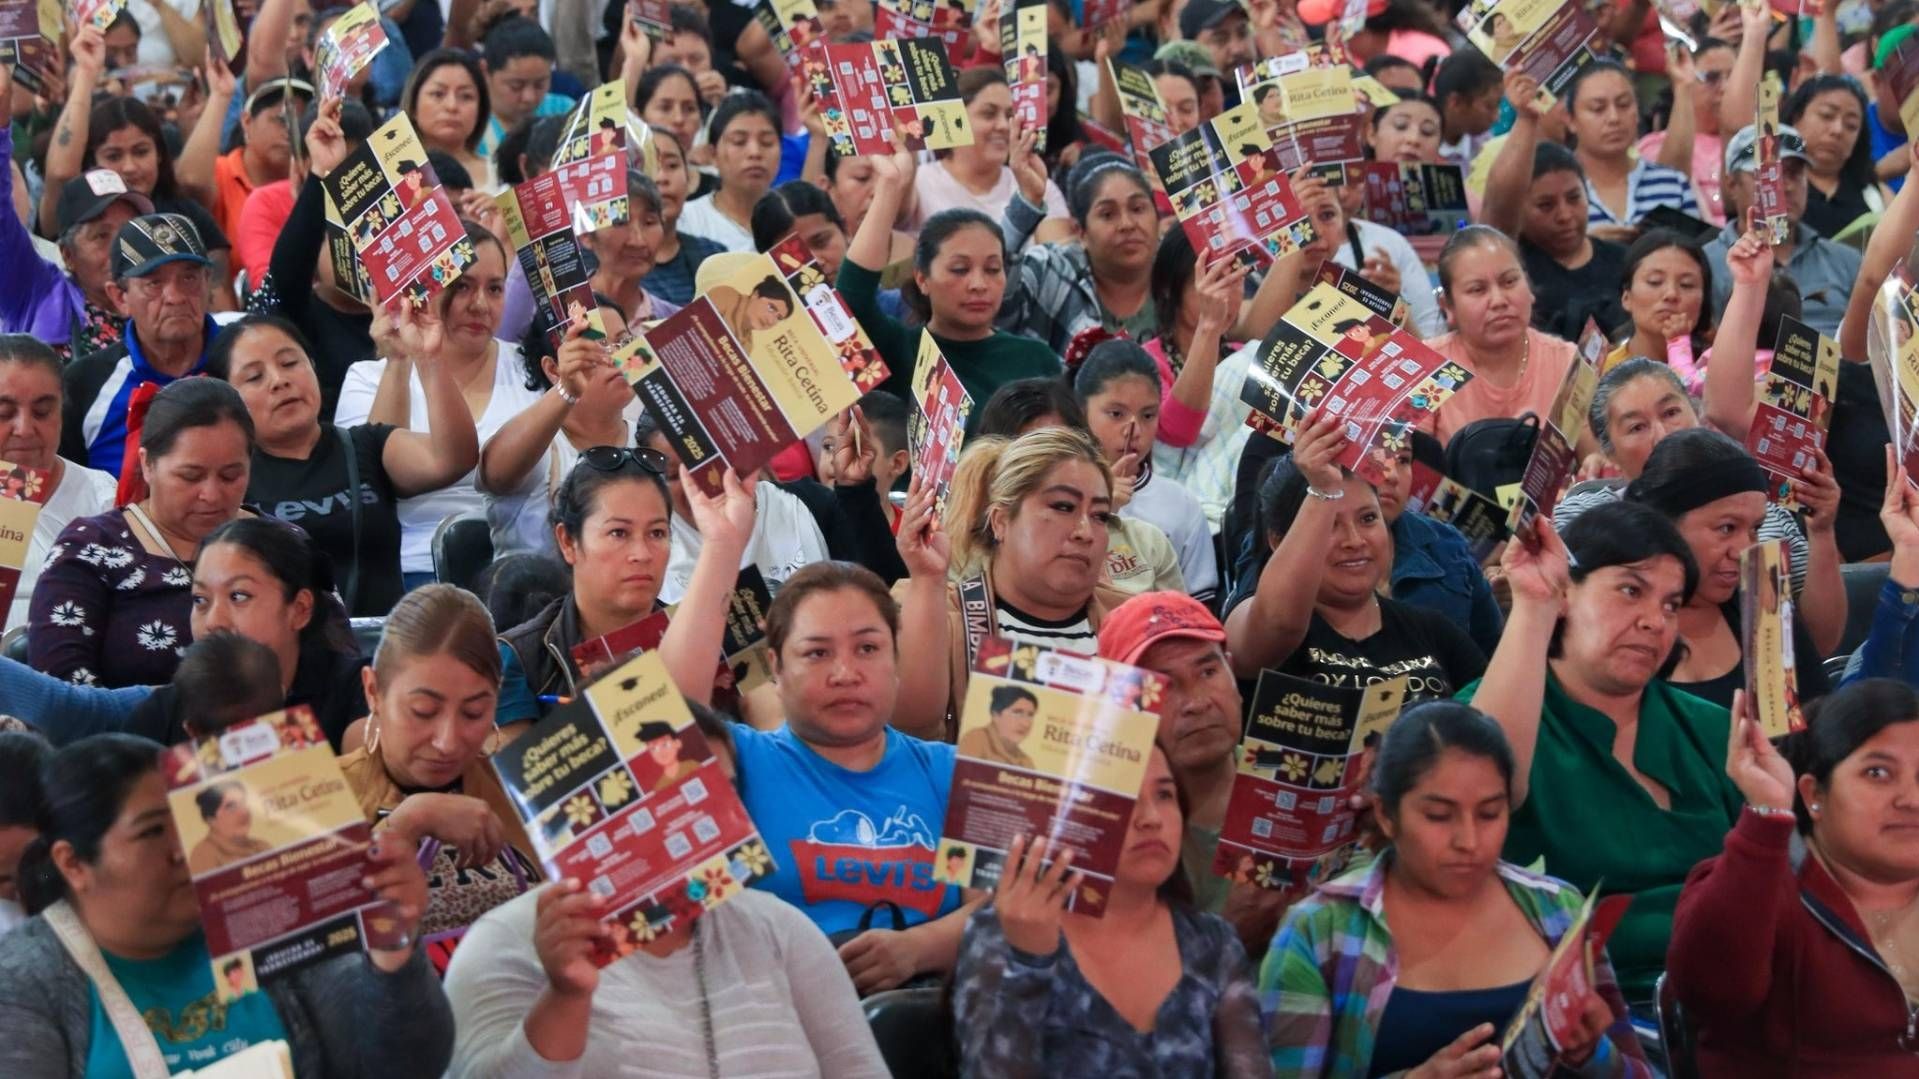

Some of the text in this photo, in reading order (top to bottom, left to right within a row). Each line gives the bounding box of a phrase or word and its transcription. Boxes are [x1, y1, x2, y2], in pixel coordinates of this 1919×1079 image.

[718, 335, 741, 366] Becas
[737, 364, 773, 411] Bienestar
[1279, 342, 1298, 365] más
[1280, 367, 1292, 380] tu
[1289, 339, 1315, 367] beca?
[773, 335, 798, 368] Rita
[795, 366, 829, 414] Cetina
[682, 434, 705, 460] 2025
[1111, 553, 1137, 574] DIF
[1273, 704, 1343, 727] saber más
[1281, 693, 1342, 713] ¿Quieres
[522, 722, 577, 769] ¿Quieres
[1043, 724, 1081, 746] Rita
[1087, 735, 1142, 763] Cetina
[1257, 714, 1352, 741] sobre tu beca?
[523, 734, 589, 783] saber más
[552, 763, 571, 781] tu
[568, 736, 607, 770] beca?
